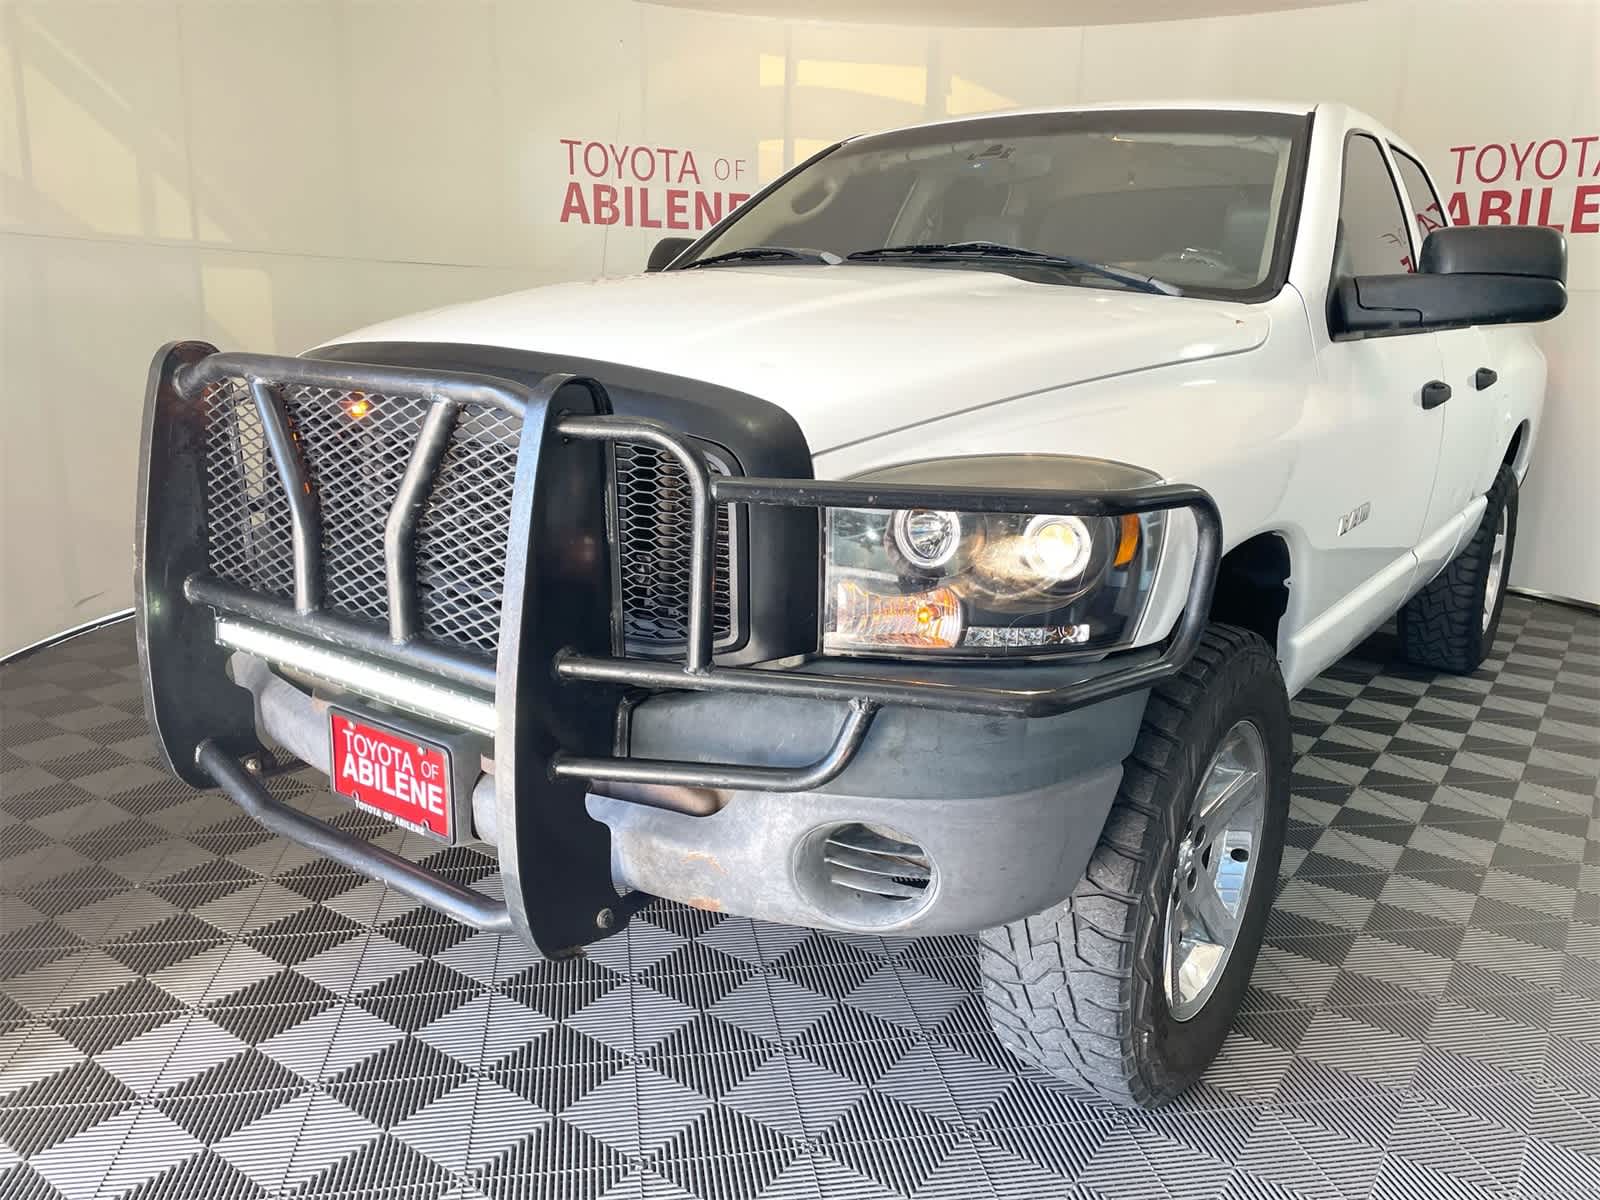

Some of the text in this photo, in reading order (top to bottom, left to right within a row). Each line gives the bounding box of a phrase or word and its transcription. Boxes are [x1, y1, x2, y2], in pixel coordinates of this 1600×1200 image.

[560, 139, 746, 184] TOYOTA OF
[1450, 136, 1600, 184] TOYOT
[342, 729, 439, 780] TOYOTA OF
[342, 753, 444, 816] ABILENE
[354, 799, 381, 817] TOYOTA
[394, 816, 425, 836] ABILENE
